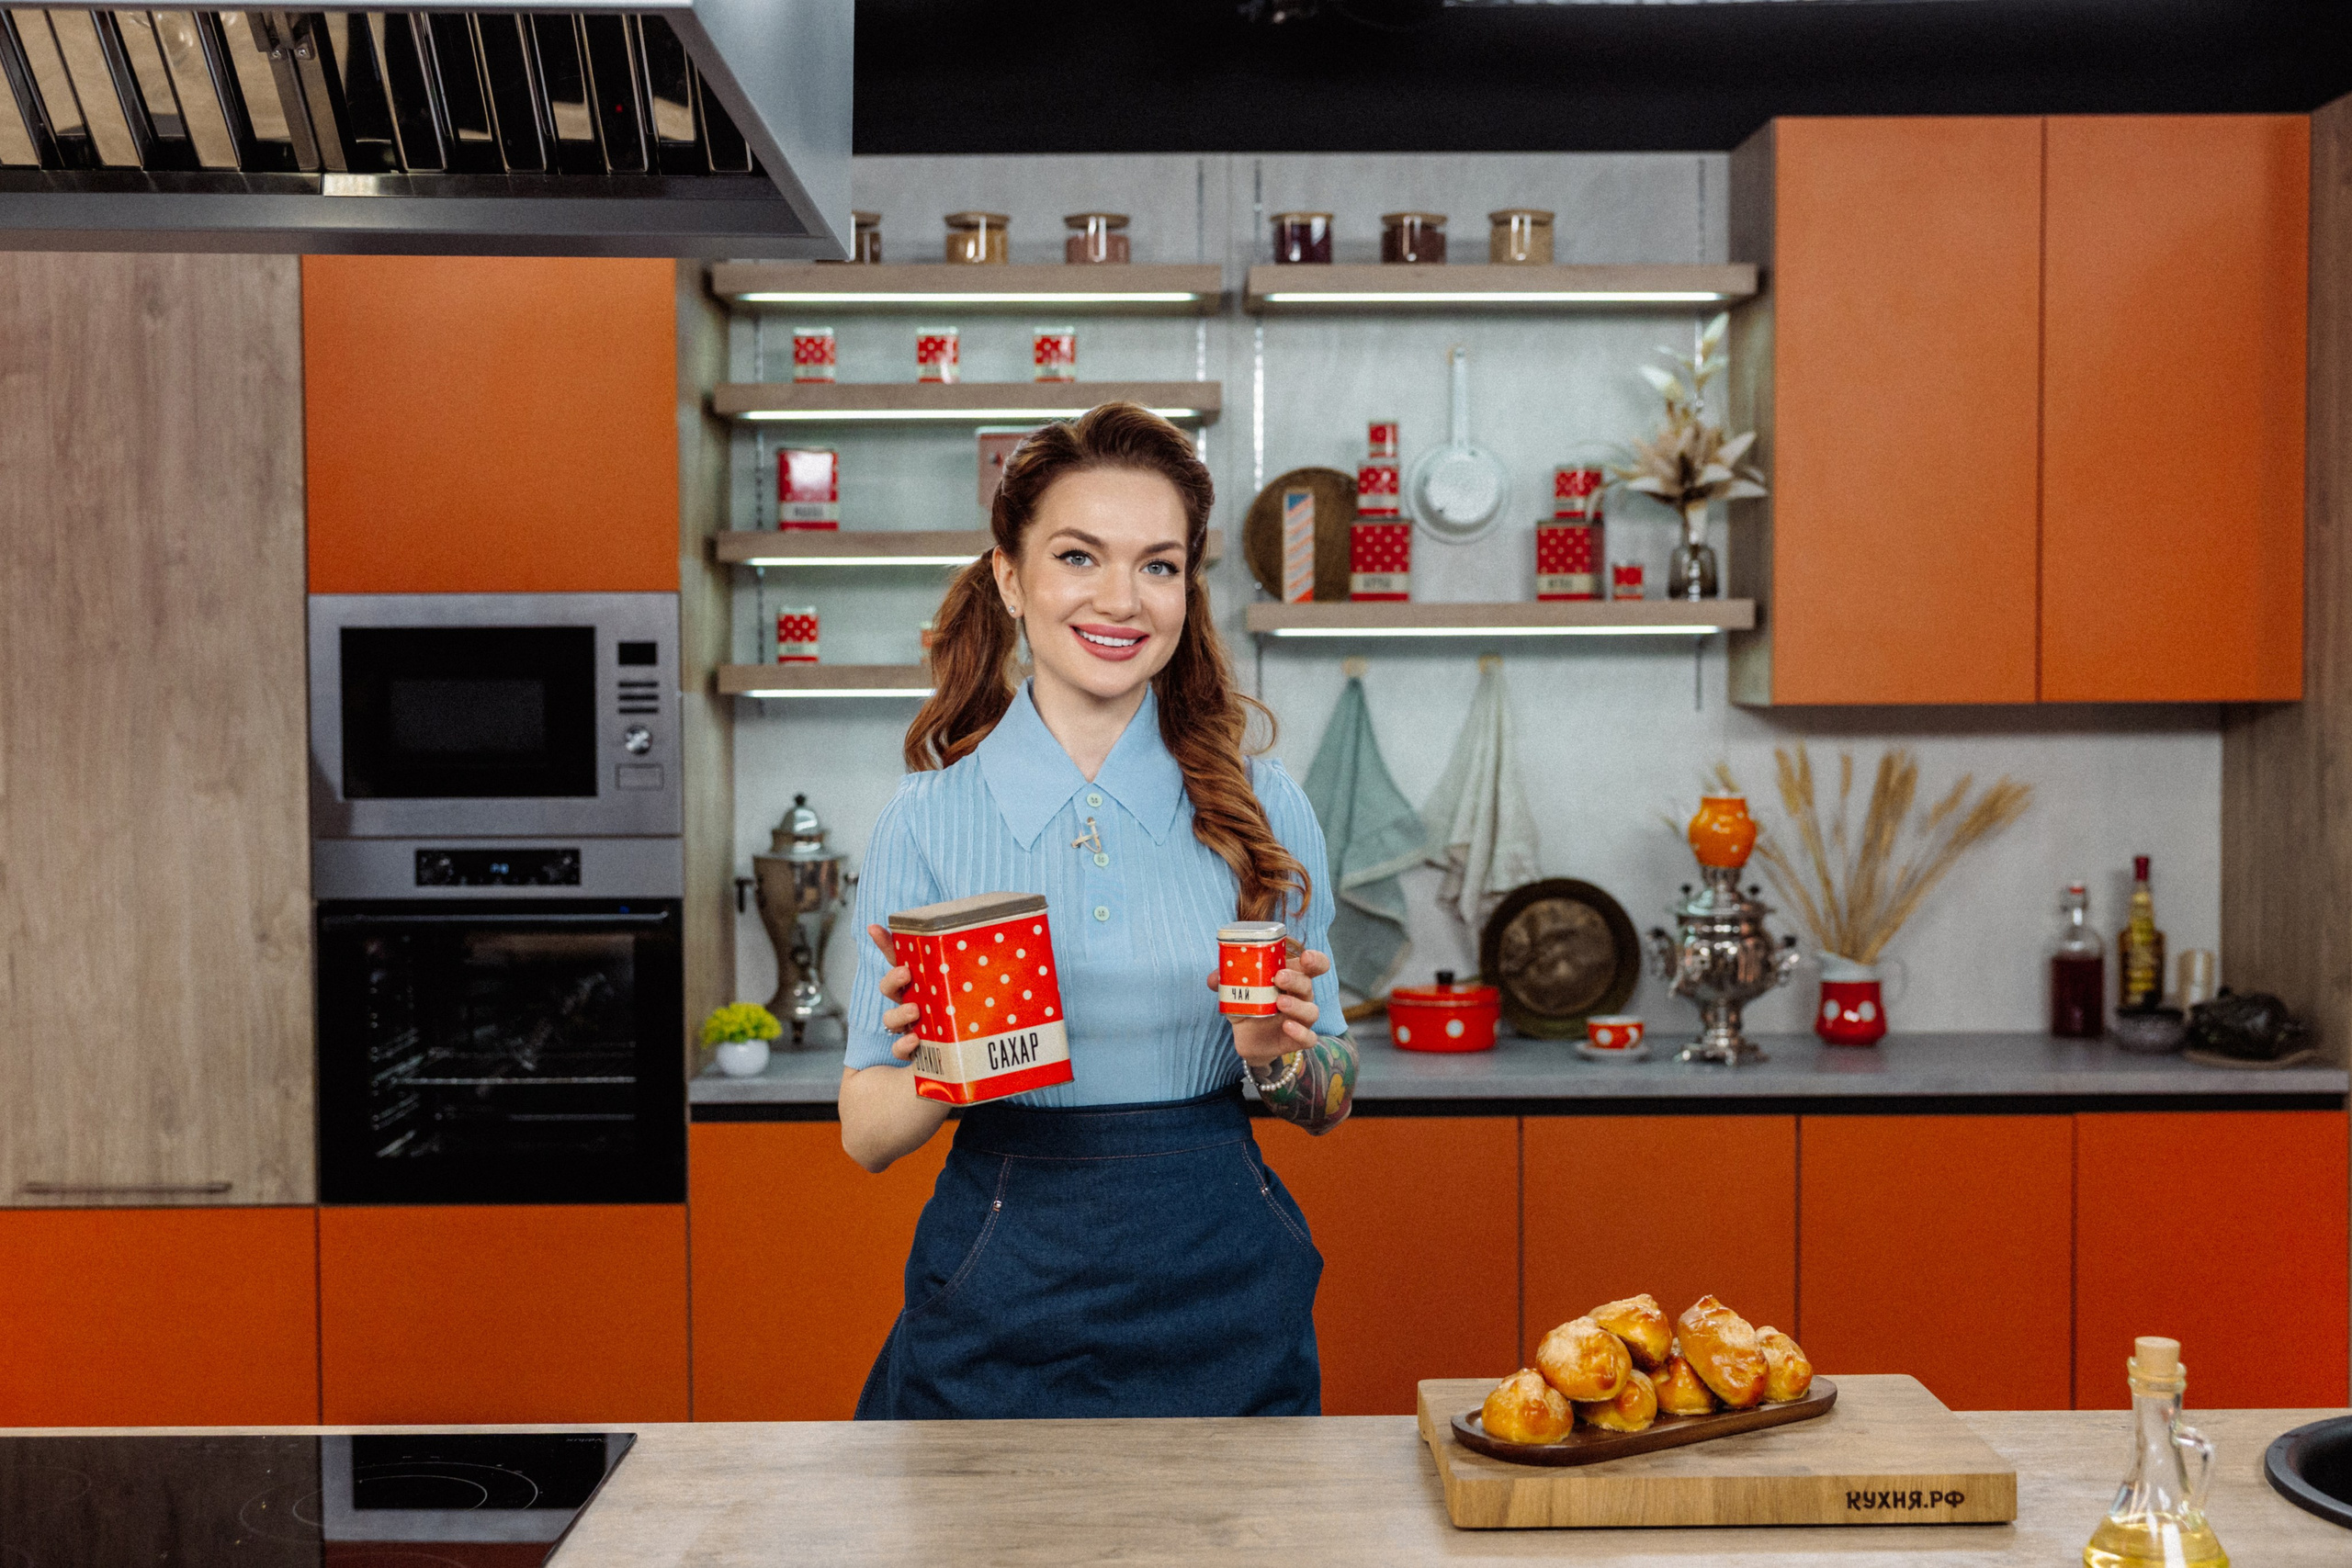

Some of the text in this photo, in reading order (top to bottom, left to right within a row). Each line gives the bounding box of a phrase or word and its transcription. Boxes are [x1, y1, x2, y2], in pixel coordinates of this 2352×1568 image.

[1231, 987, 1250, 1000] ЧАЙ
[988, 1032, 1038, 1071] САХАР
[1846, 1490, 1965, 1511] КУХНЯ.РФ
